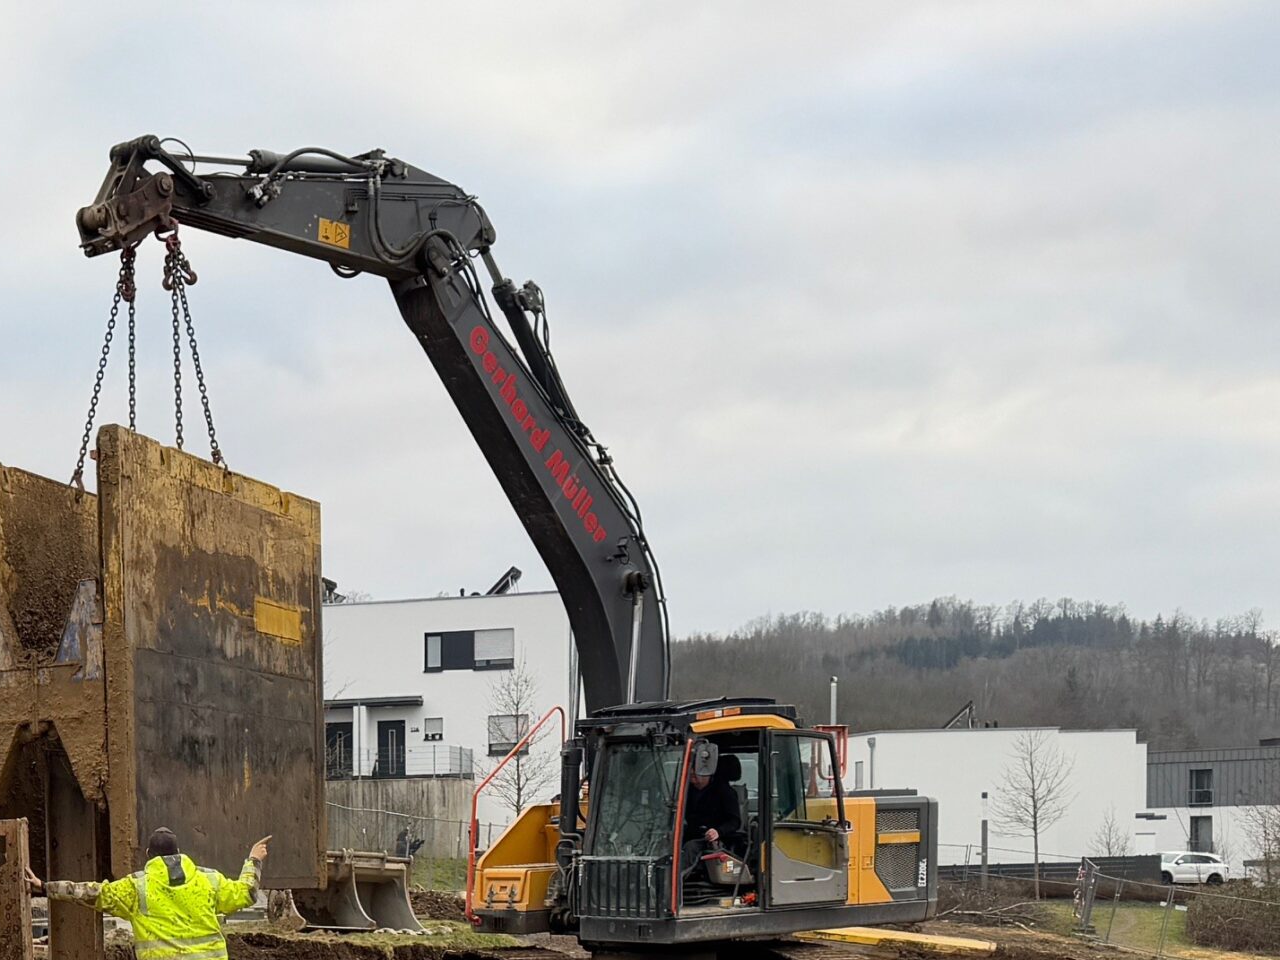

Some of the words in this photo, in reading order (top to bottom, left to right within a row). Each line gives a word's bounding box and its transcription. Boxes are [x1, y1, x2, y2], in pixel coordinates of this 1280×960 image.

[469, 325, 551, 454] Gerhard
[544, 449, 607, 543] Müller
[623, 743, 672, 752] VOLO
